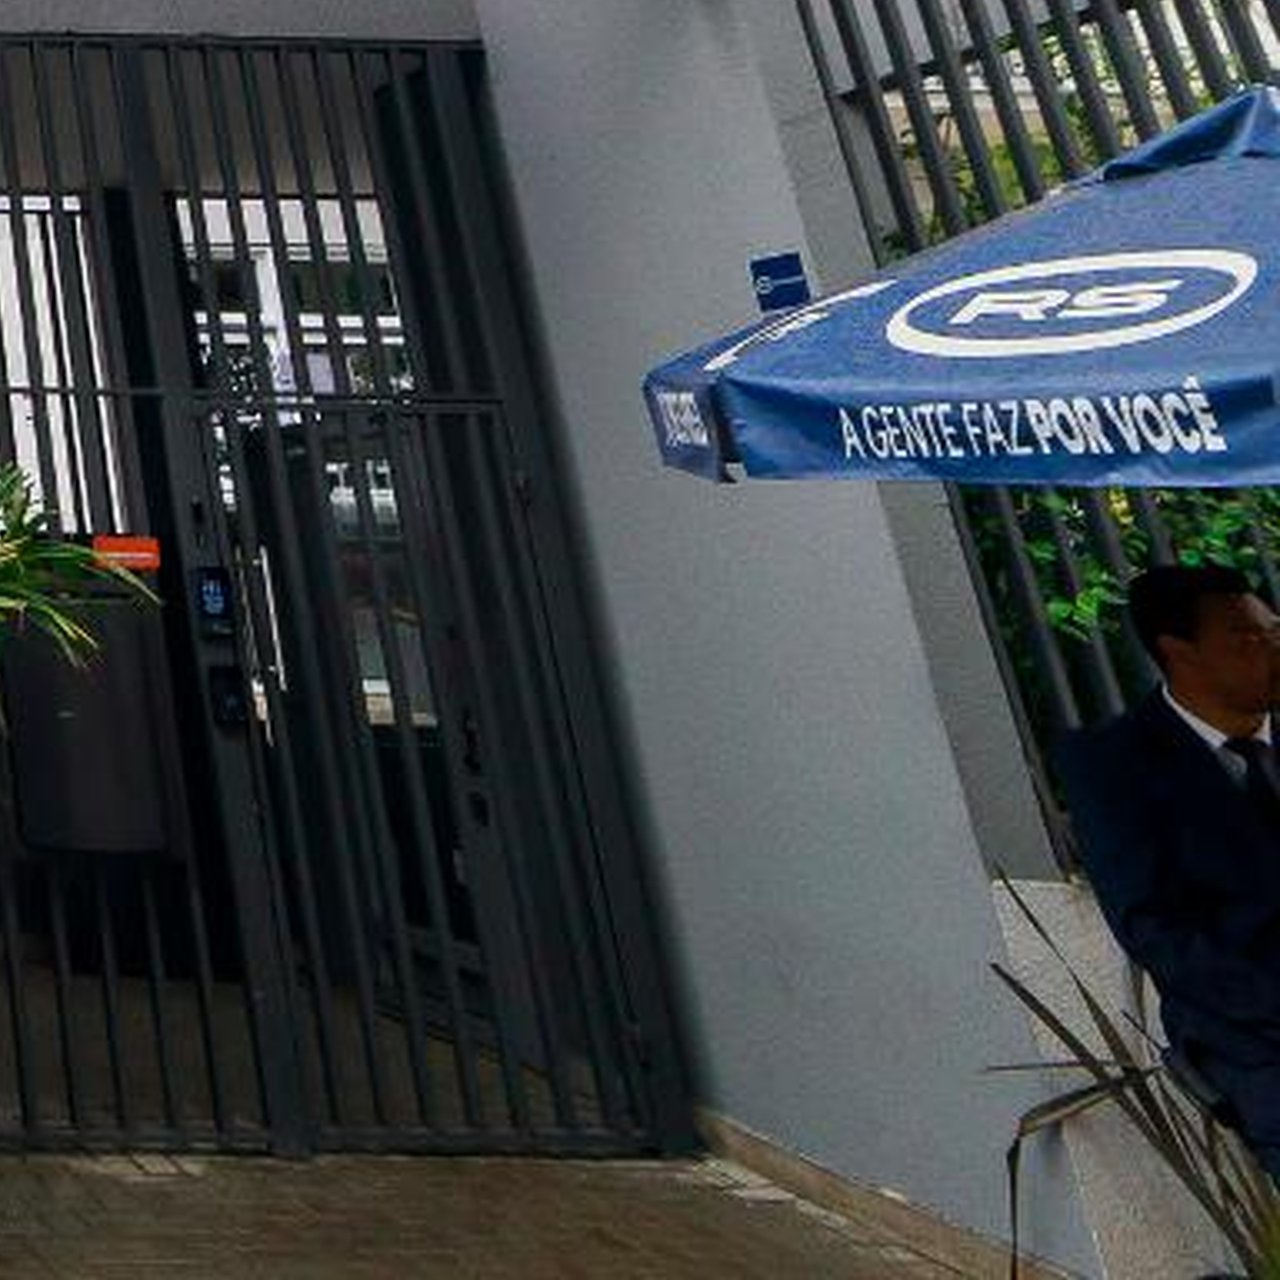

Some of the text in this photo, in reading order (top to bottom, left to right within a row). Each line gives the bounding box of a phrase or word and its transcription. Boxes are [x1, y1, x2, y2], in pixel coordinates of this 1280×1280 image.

[948, 278, 1185, 325] RS
[840, 374, 1229, 459] A GENTE FAZ POR VOCÊ
